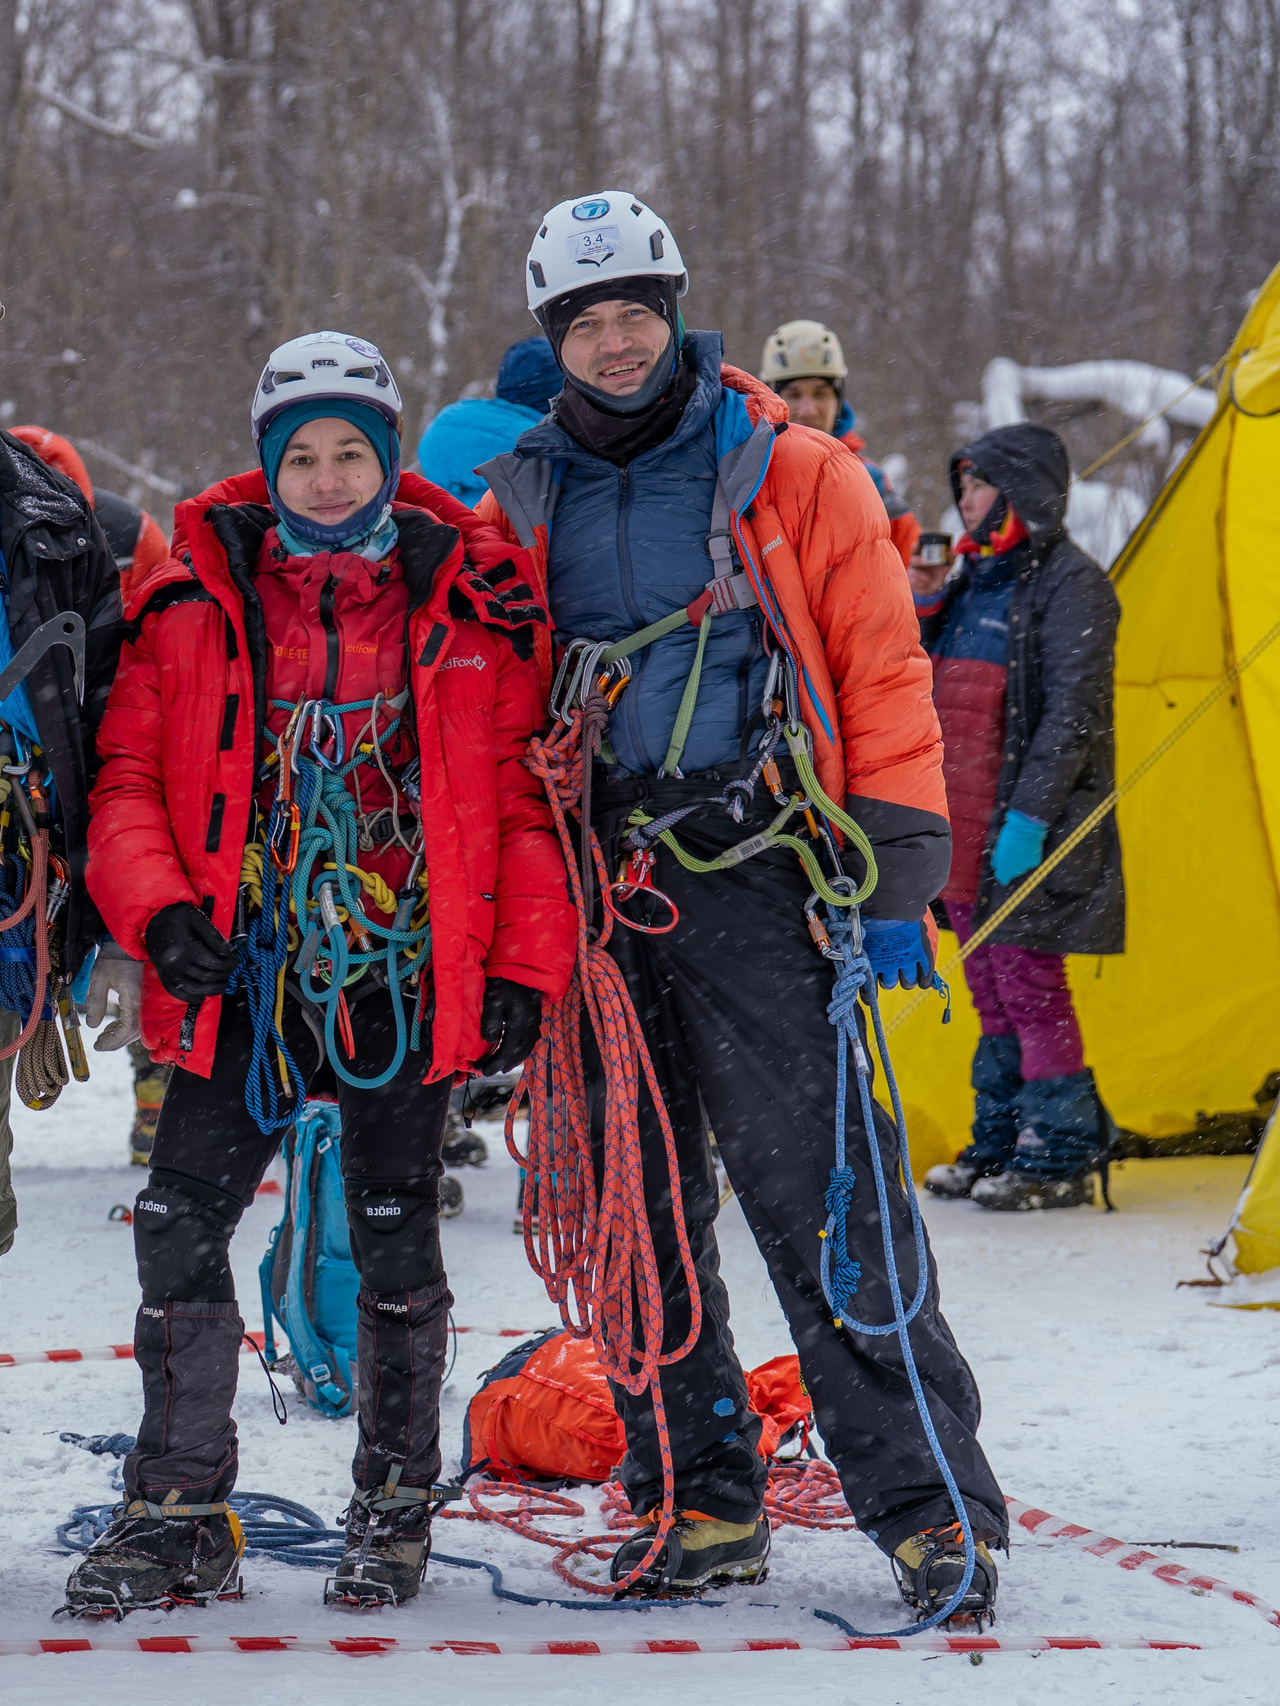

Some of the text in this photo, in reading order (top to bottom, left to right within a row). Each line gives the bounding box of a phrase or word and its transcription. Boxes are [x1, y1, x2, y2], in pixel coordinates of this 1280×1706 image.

[583, 233, 604, 247] 3.4
[311, 359, 339, 369] PETZL
[761, 535, 783, 560] mond
[274, 646, 310, 659] ORE-TE
[345, 643, 376, 654] edFox
[438, 657, 473, 671] edFox
[139, 1200, 168, 1214] BJÖRD
[366, 1205, 401, 1216] BJÖRD
[377, 1302, 408, 1313] СПЛАВ
